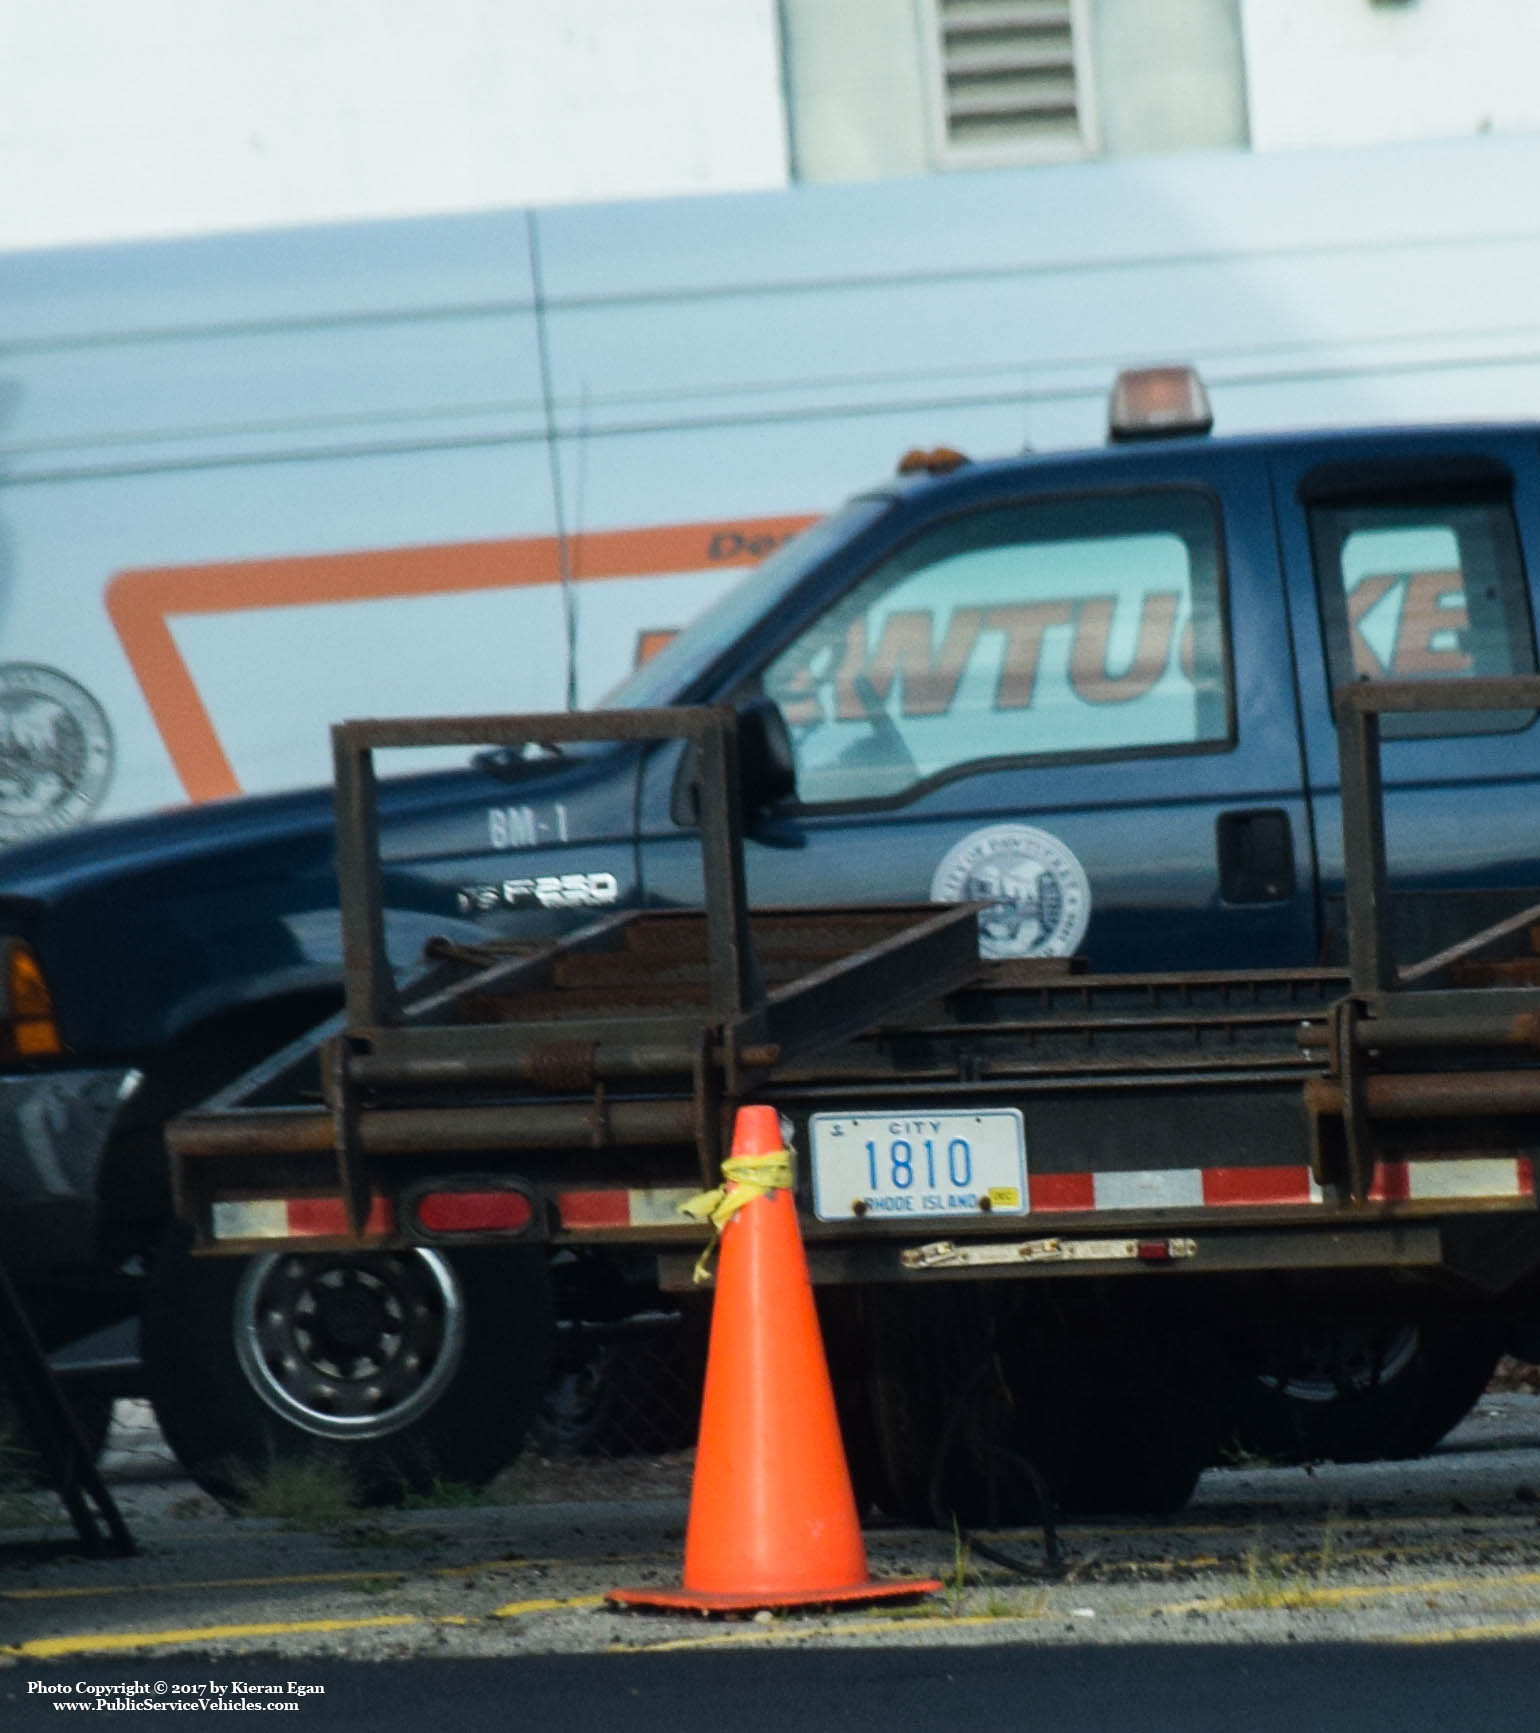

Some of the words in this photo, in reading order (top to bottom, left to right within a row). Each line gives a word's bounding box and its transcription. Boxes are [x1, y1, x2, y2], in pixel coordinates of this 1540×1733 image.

[889, 1121, 942, 1135] CITY
[865, 1138, 972, 1190] 1810
[863, 1196, 913, 1212] RHODE
[922, 1193, 978, 1211] ISLAND
